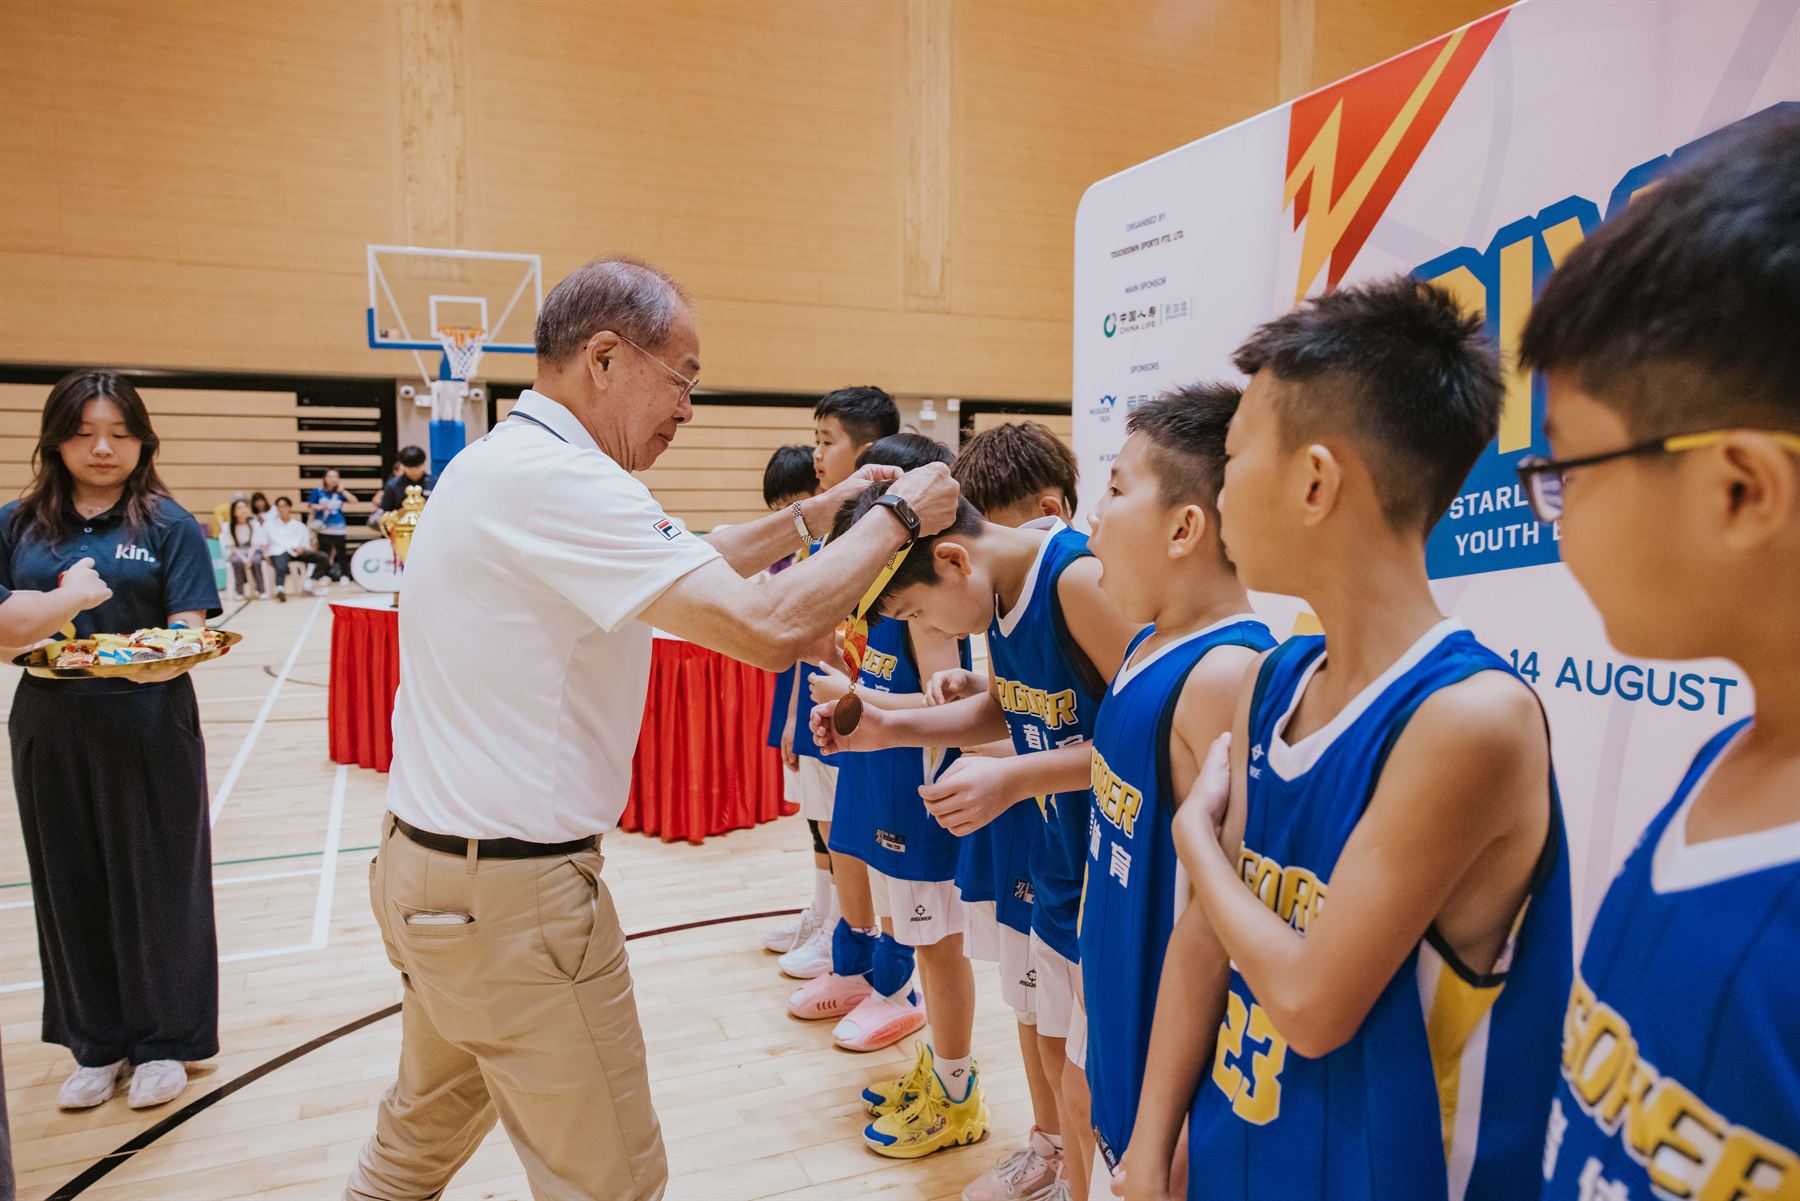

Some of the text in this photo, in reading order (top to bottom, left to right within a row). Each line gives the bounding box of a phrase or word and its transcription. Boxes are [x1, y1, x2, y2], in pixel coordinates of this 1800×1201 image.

[1140, 276, 1167, 291] SPONSOR
[1120, 320, 1155, 334] CHINA LIFE
[1130, 361, 1159, 374] SPONSORS
[1449, 483, 1529, 520] STARL
[1455, 521, 1540, 556] YOUTH
[1555, 656, 1738, 716] AUGUST
[1211, 989, 1288, 1126] 23
